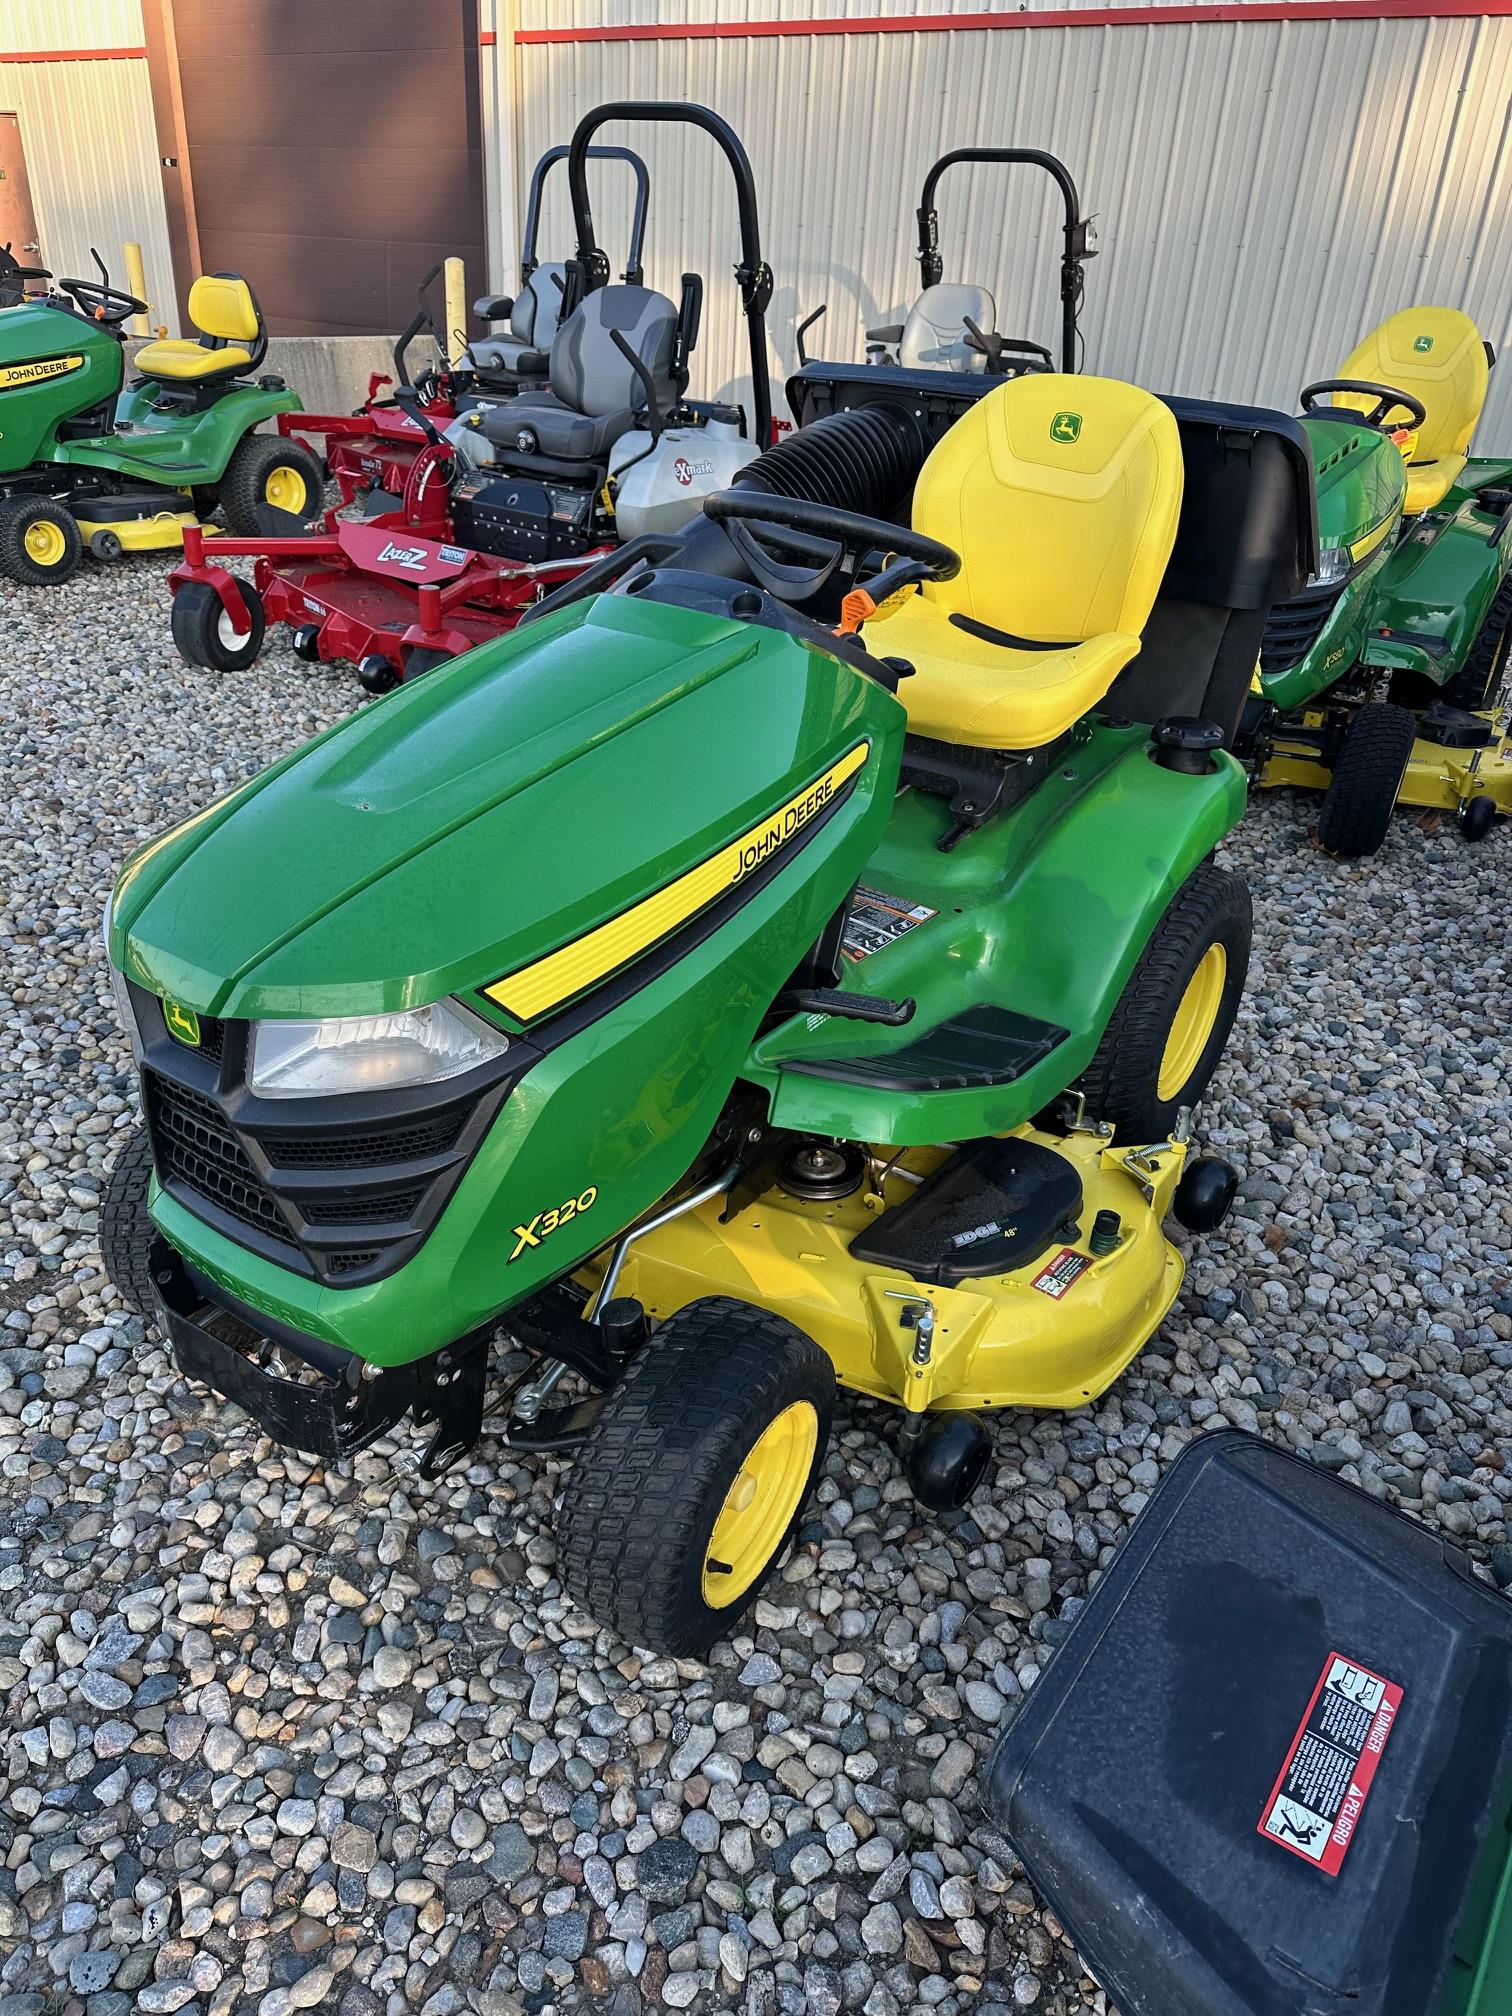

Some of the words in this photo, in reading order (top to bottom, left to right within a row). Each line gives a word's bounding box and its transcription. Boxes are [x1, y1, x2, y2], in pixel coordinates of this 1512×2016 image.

[5, 369, 34, 382] JOHN
[34, 361, 69, 376] DEERE
[674, 461, 713, 482] eXmark
[441, 548, 466, 562] TRITON
[733, 824, 781, 880] JOHN
[784, 776, 833, 836] DEERE
[506, 1185, 599, 1265] X320
[1366, 1711, 1391, 1753] DANGER
[1331, 1796, 1360, 1847] PELIGRO
